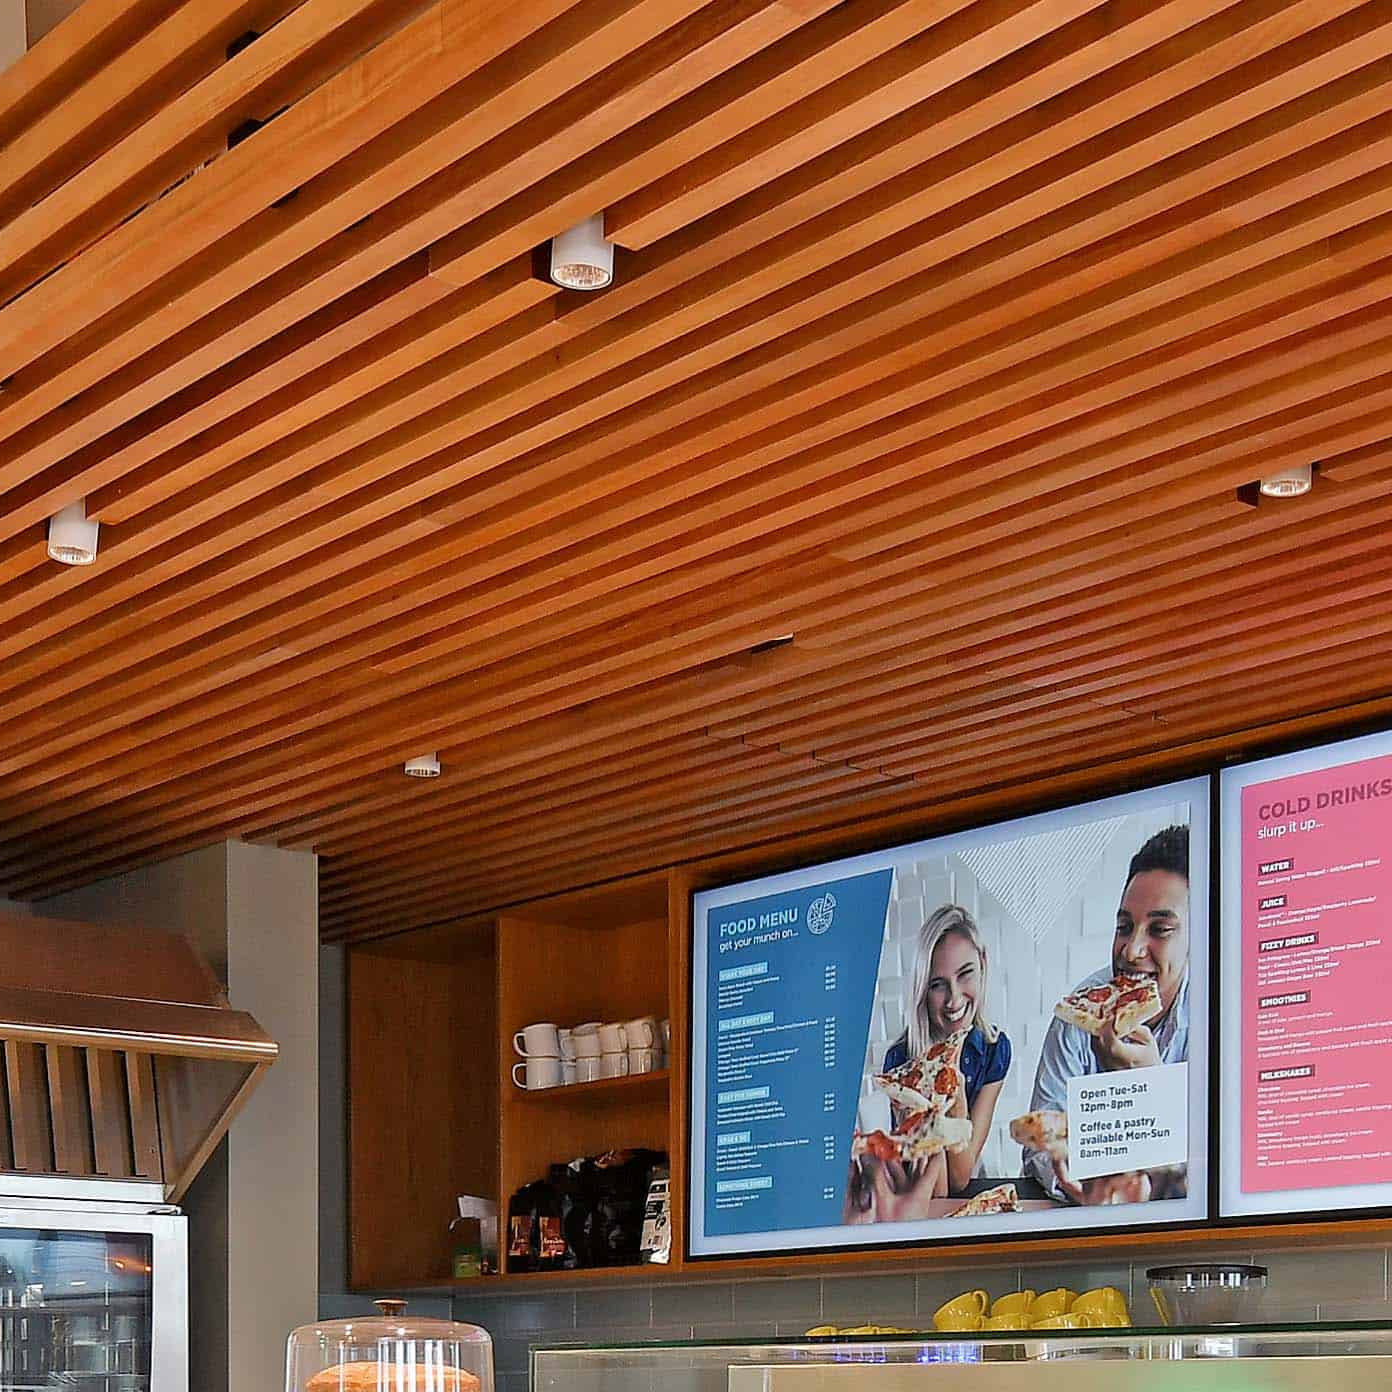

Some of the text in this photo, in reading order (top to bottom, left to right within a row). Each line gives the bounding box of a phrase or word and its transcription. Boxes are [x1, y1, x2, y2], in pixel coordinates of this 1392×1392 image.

[1258, 779, 1392, 821] COLD DRINKS
[1257, 819, 1325, 840] slurp it up...
[1260, 861, 1290, 874] WATER
[1260, 897, 1285, 909] JUICE
[720, 907, 798, 937] FOOD MENU
[719, 940, 732, 953] get
[734, 937, 752, 950] your
[753, 930, 781, 945] munch
[1080, 1083, 1148, 1101] Open Tue-Sat
[1080, 1099, 1134, 1113] 12pm-8pm
[1080, 1117, 1156, 1133] Coffee & pastry
[1080, 1128, 1170, 1145] available Mon-Sun
[1080, 1146, 1128, 1159] 8am-11am
